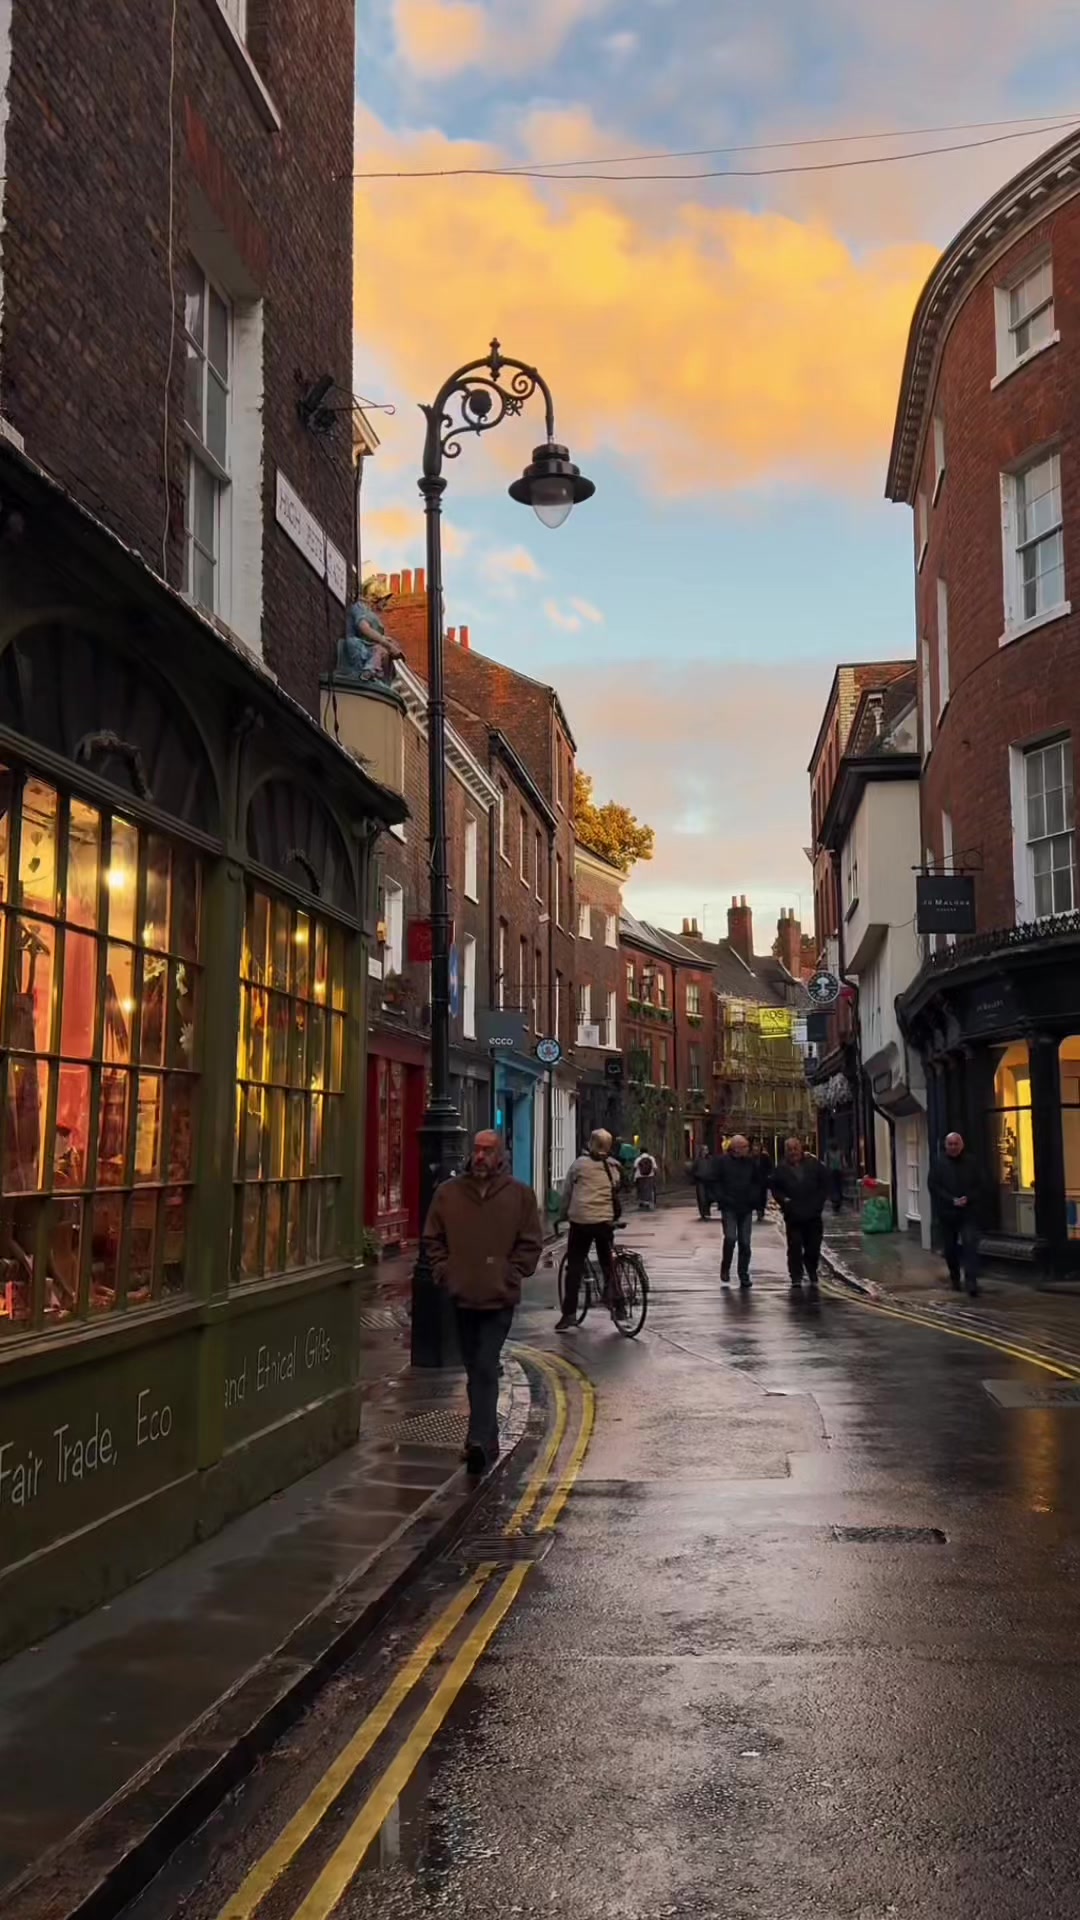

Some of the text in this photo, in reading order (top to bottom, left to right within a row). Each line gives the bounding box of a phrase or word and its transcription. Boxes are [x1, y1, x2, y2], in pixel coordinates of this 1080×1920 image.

[488, 1037, 514, 1046] ecco
[0, 1389, 172, 1507] Fair Trade, Eco
